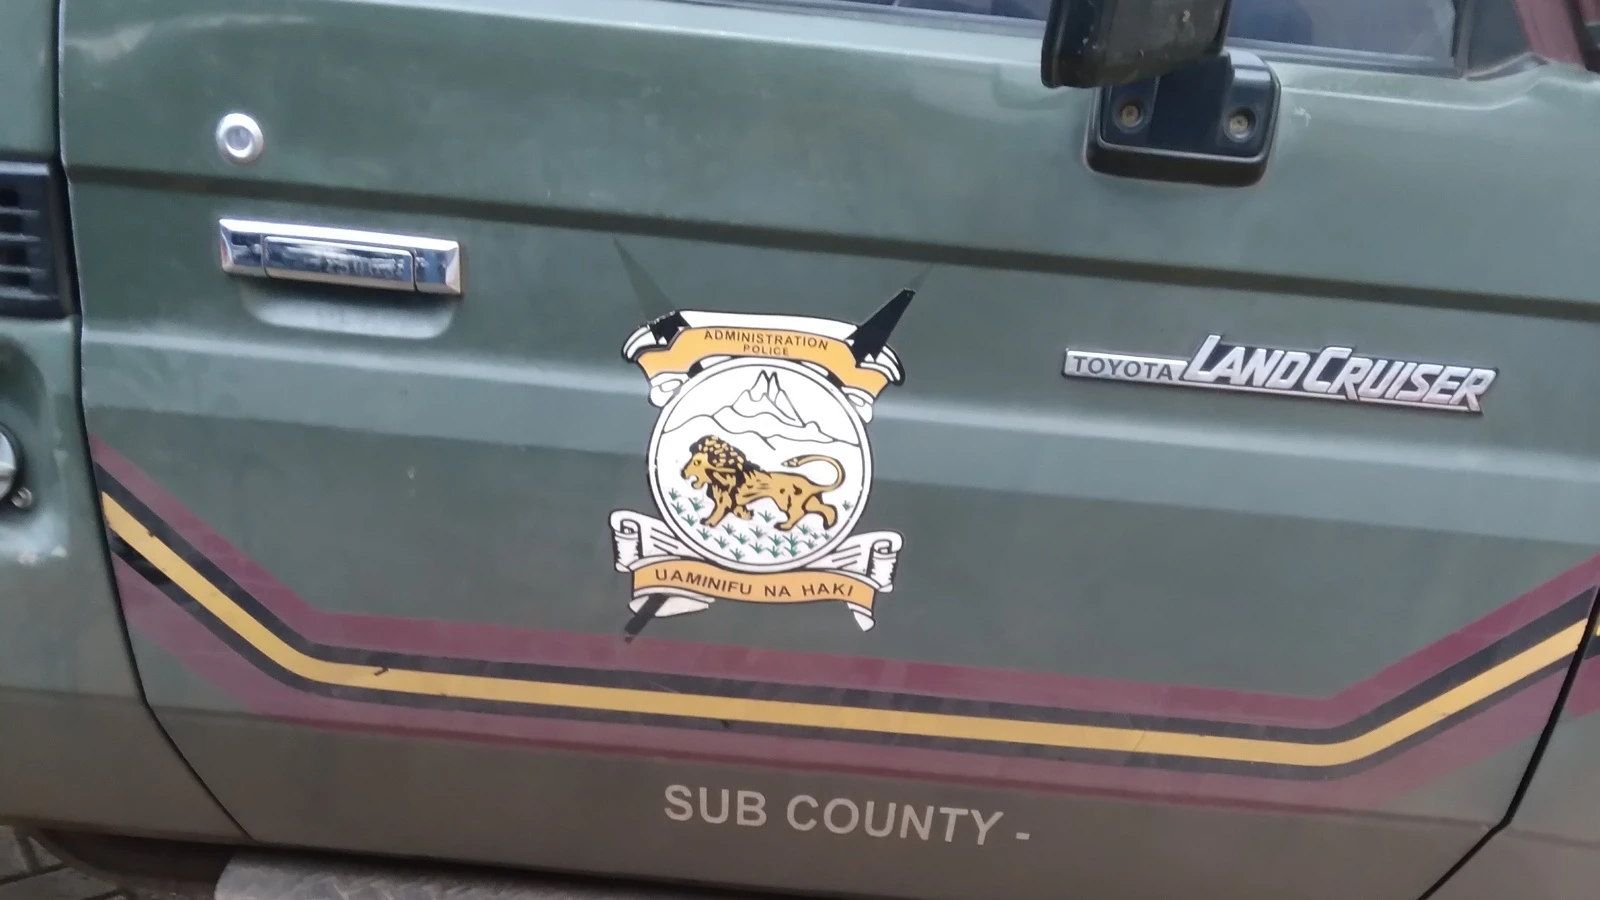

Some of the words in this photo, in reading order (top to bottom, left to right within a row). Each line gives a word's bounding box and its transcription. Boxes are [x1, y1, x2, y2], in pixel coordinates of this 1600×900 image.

[703, 329, 829, 351] ADMINISTRATION
[743, 343, 789, 357] POLICE
[1072, 355, 1174, 381] TOYOTA
[655, 568, 752, 595] UAMINIFU
[764, 584, 791, 597] NA
[802, 582, 854, 597] HAKI
[664, 784, 767, 827] SUB
[786, 794, 1004, 846] COUNTY
